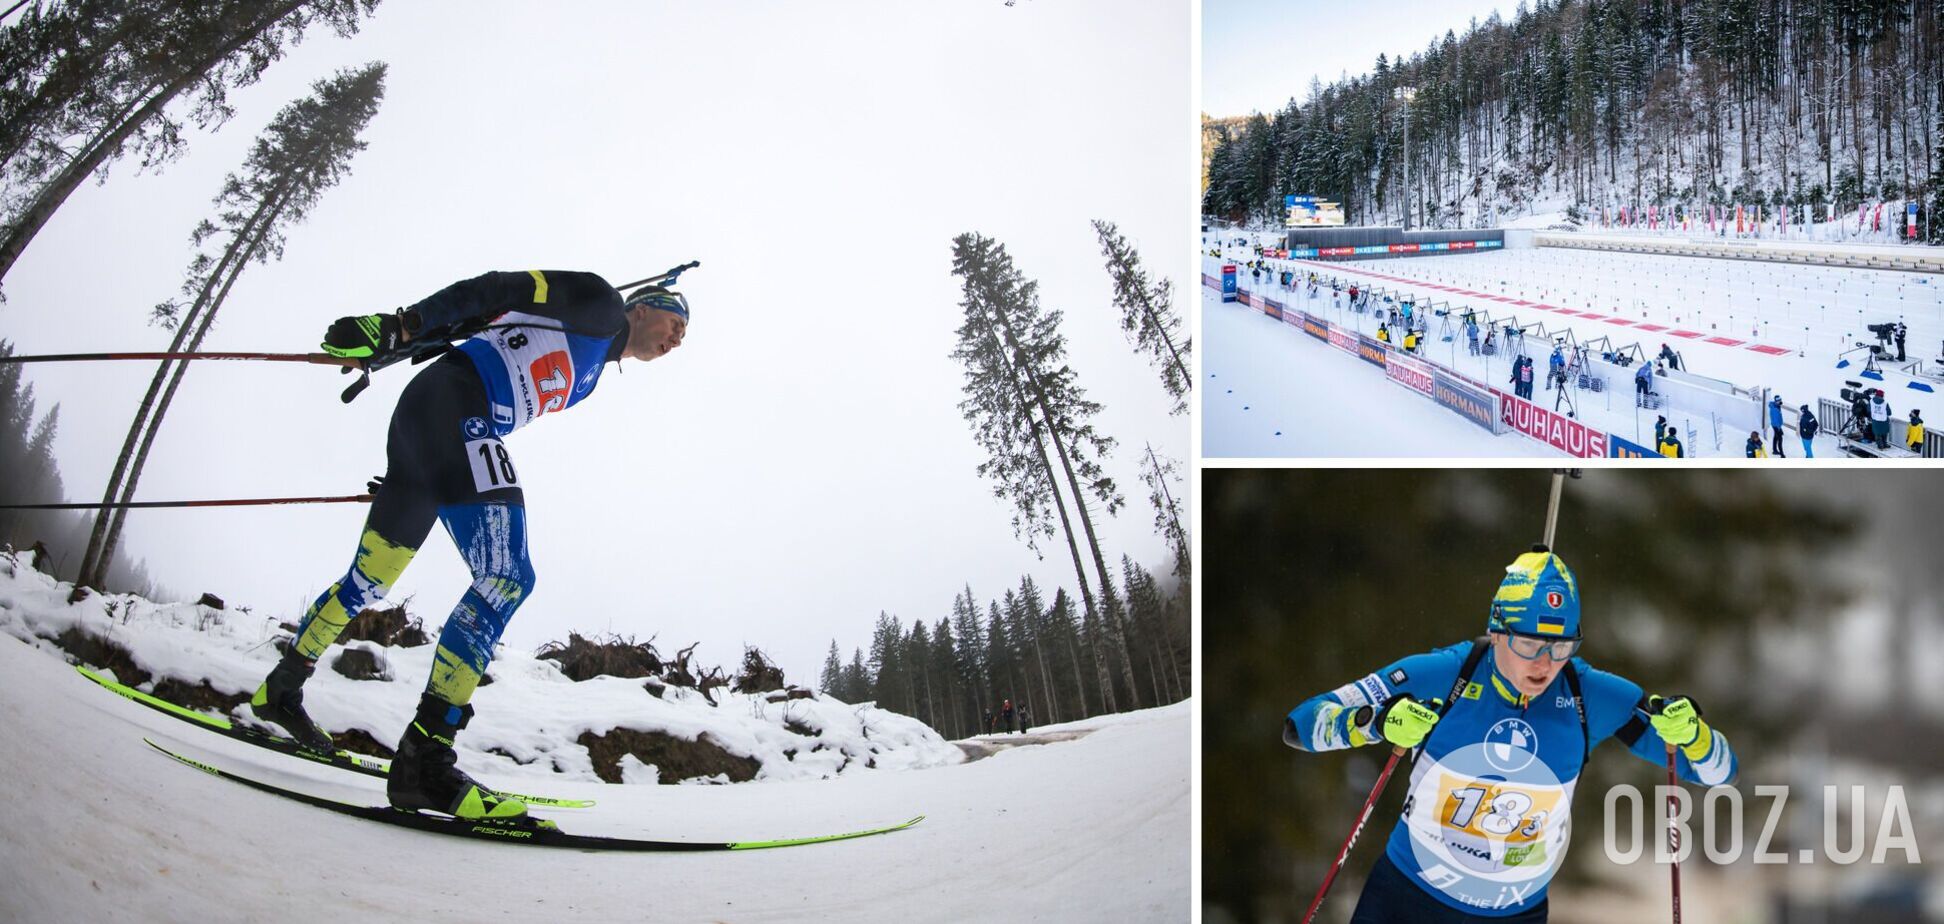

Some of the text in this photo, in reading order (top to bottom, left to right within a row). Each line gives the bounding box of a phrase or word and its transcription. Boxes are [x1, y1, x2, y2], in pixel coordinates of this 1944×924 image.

[1386, 361, 1433, 395] BAUHAUS
[1503, 399, 1605, 458] AUHAUS
[478, 443, 517, 487] 18
[1555, 696, 1575, 709] BM
[1494, 720, 1532, 737] BMW
[1450, 787, 1533, 835] 18
[471, 826, 533, 839] FISCHER
[1337, 802, 1374, 868] SWIX
[1458, 882, 1533, 910] THE iX
